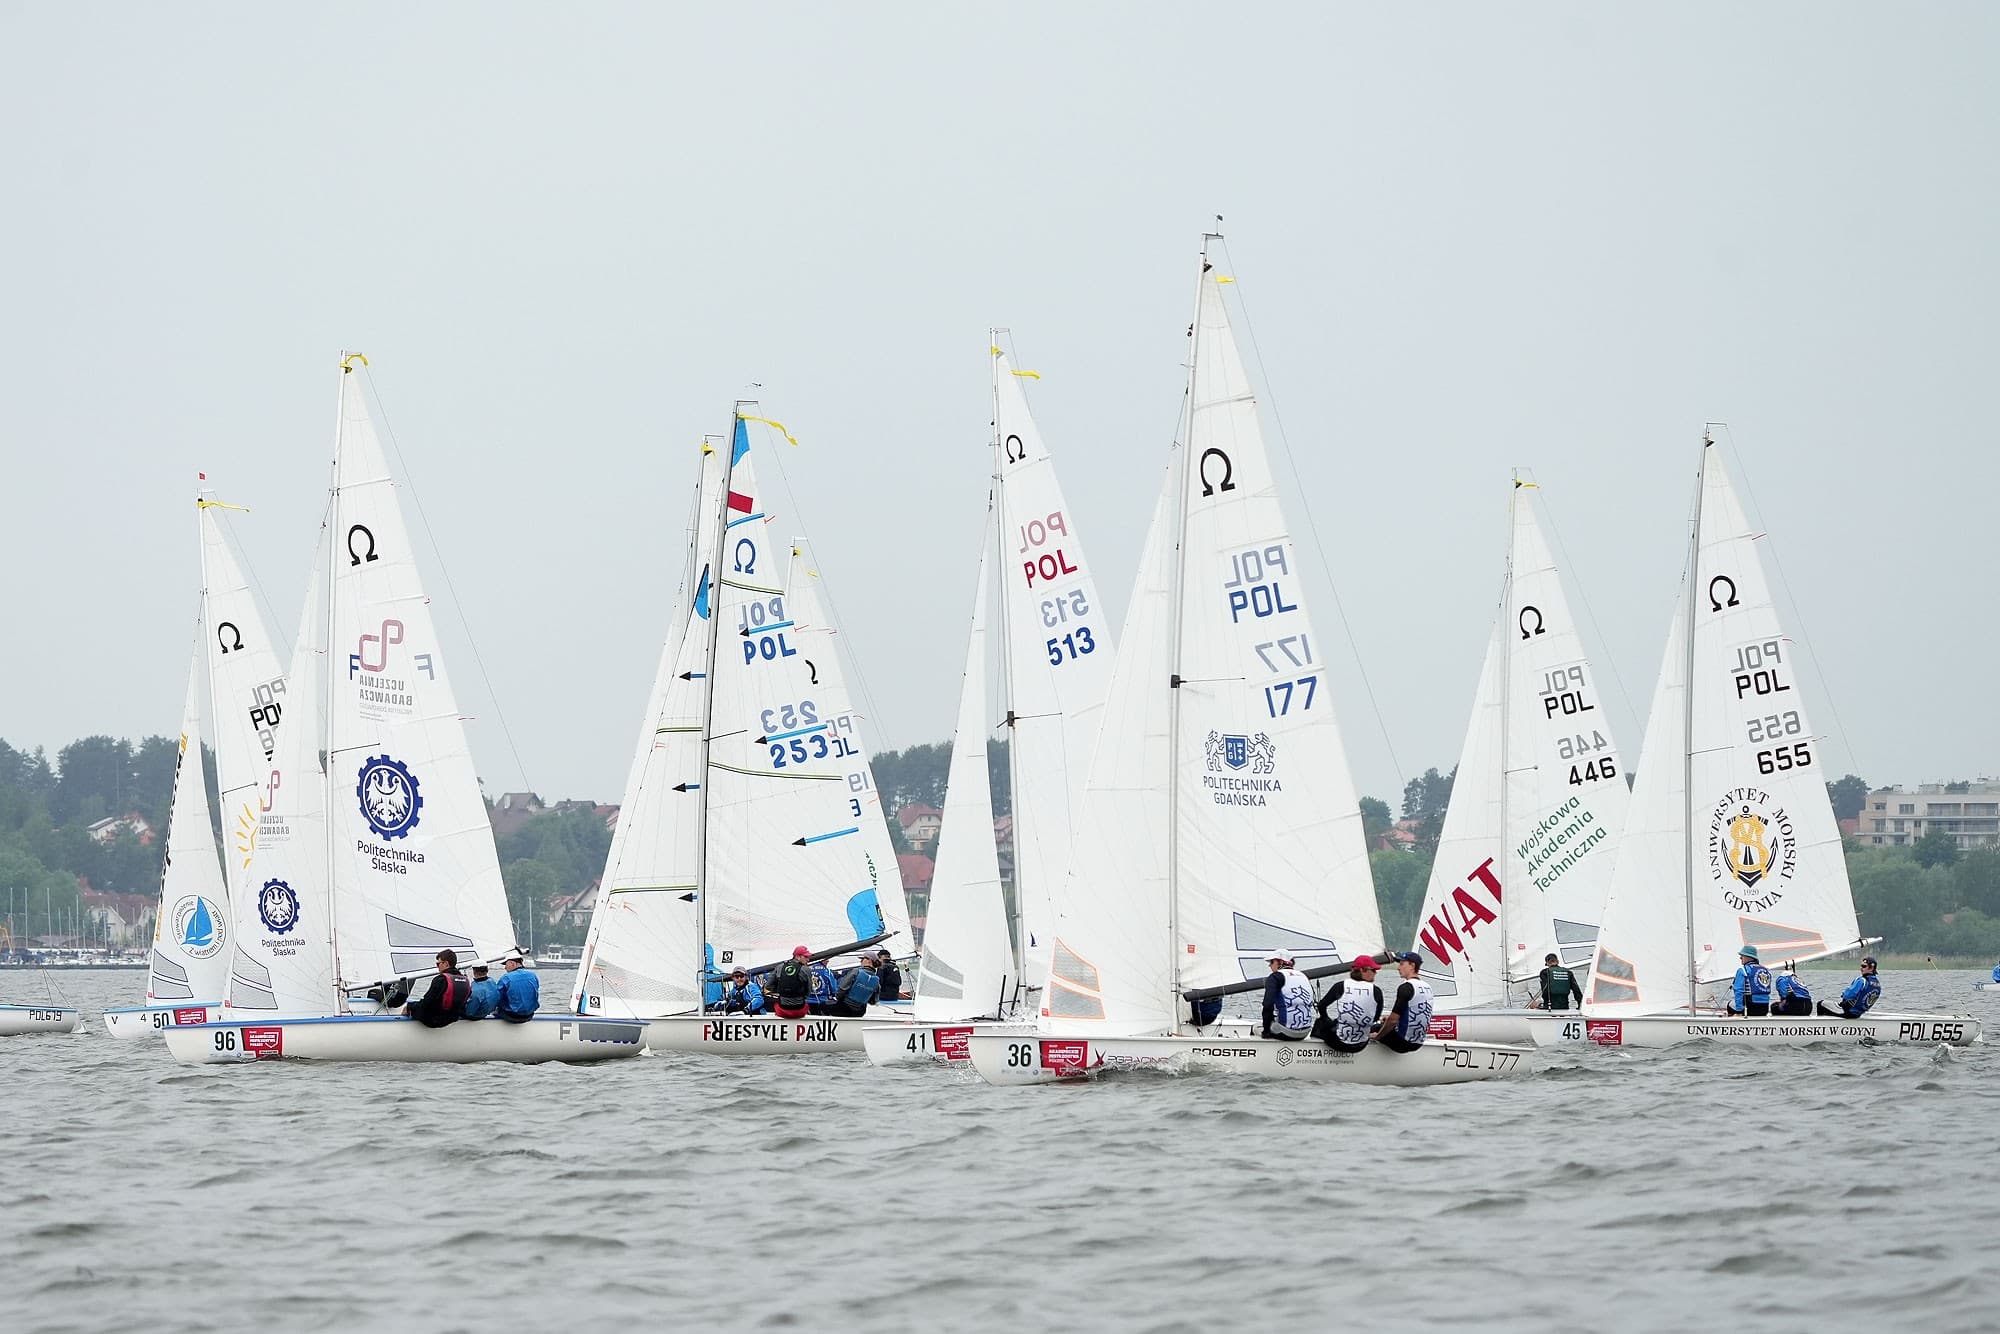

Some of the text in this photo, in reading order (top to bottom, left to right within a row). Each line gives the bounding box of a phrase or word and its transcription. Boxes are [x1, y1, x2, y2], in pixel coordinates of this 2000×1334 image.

[1023, 549, 1078, 589] POL
[1229, 582, 1298, 624] POL
[743, 633, 797, 665] POL
[1046, 626, 1096, 666] 513
[1264, 676, 1317, 718] 177
[1735, 669, 1790, 700] POL
[1544, 691, 1595, 719] POL
[770, 734, 830, 769] 253
[1756, 742, 1812, 775] 655
[1203, 775, 1282, 792] POLITECHNIKA
[1568, 757, 1618, 787] 446
[1213, 790, 1267, 807] GDAŃSKA
[1516, 795, 1581, 860] Wojskowa
[1708, 787, 1797, 881] UNIWERSYTET MORSKI
[357, 840, 425, 863] Politechnika
[1527, 808, 1594, 877] Akademia
[371, 856, 407, 875] Śląska
[1532, 827, 1607, 895] Techniczna
[1420, 857, 1502, 966] WAT
[1723, 889, 1784, 914] GDYNIA
[261, 938, 306, 948] Politechnika
[153, 1013, 170, 1029] 50
[703, 1020, 838, 1042] FREESTYLE PARK
[1562, 1022, 1581, 1040] 45
[1686, 1025, 1877, 1037] UNIWERSYTET MORSKI W GDYNI
[214, 1031, 236, 1051] 96
[906, 1032, 926, 1053] 41
[1007, 1044, 1032, 1068] 36
[1442, 1043, 1520, 1071] POL 177
